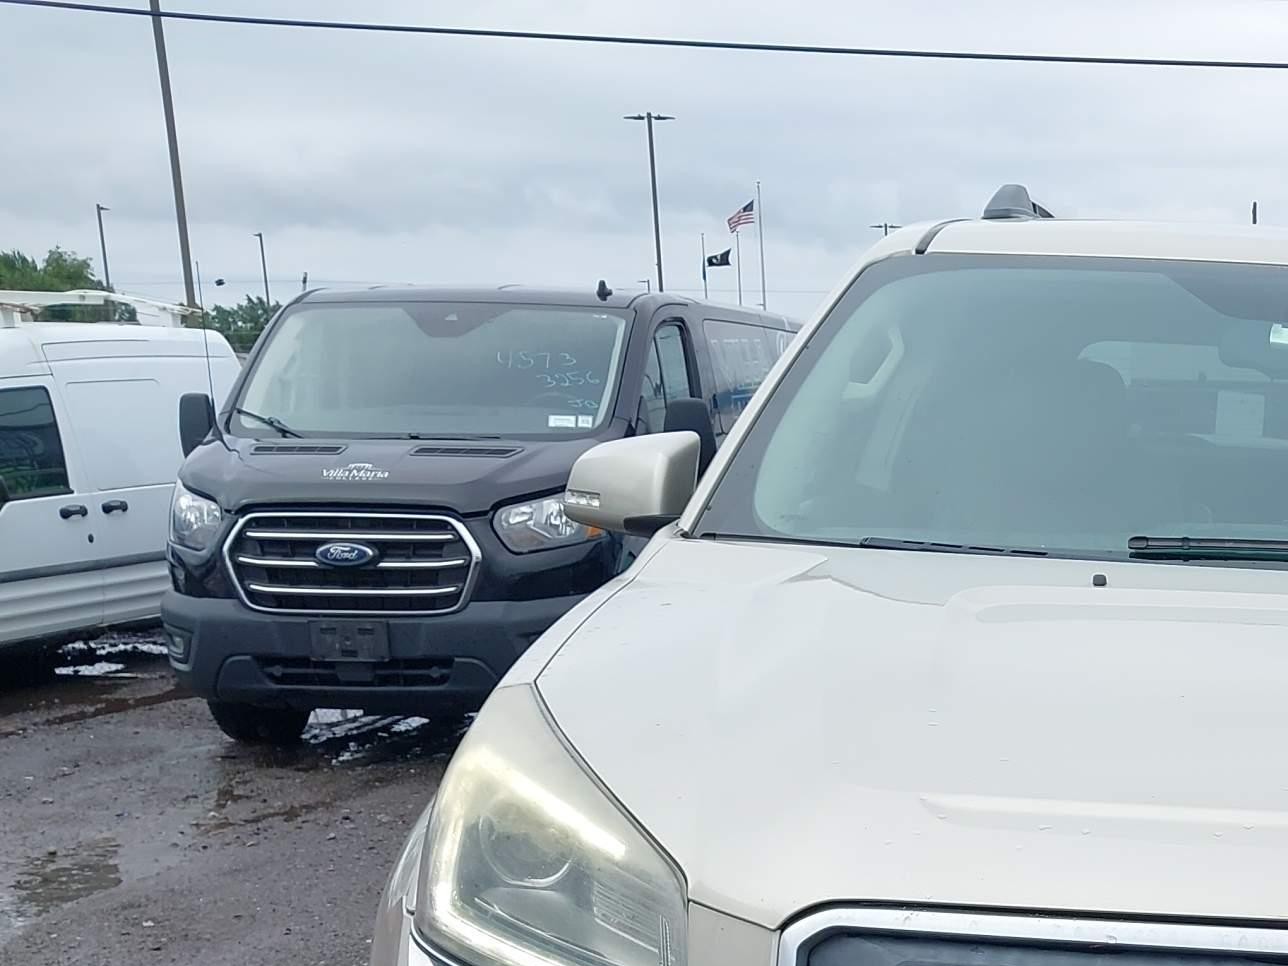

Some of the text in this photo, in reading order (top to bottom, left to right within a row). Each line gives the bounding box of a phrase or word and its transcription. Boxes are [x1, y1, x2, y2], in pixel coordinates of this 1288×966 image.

[497, 351, 577, 369] 4573
[535, 370, 600, 388] 3256
[322, 469, 389, 480] Villa Maria
[327, 546, 359, 560] Ford
